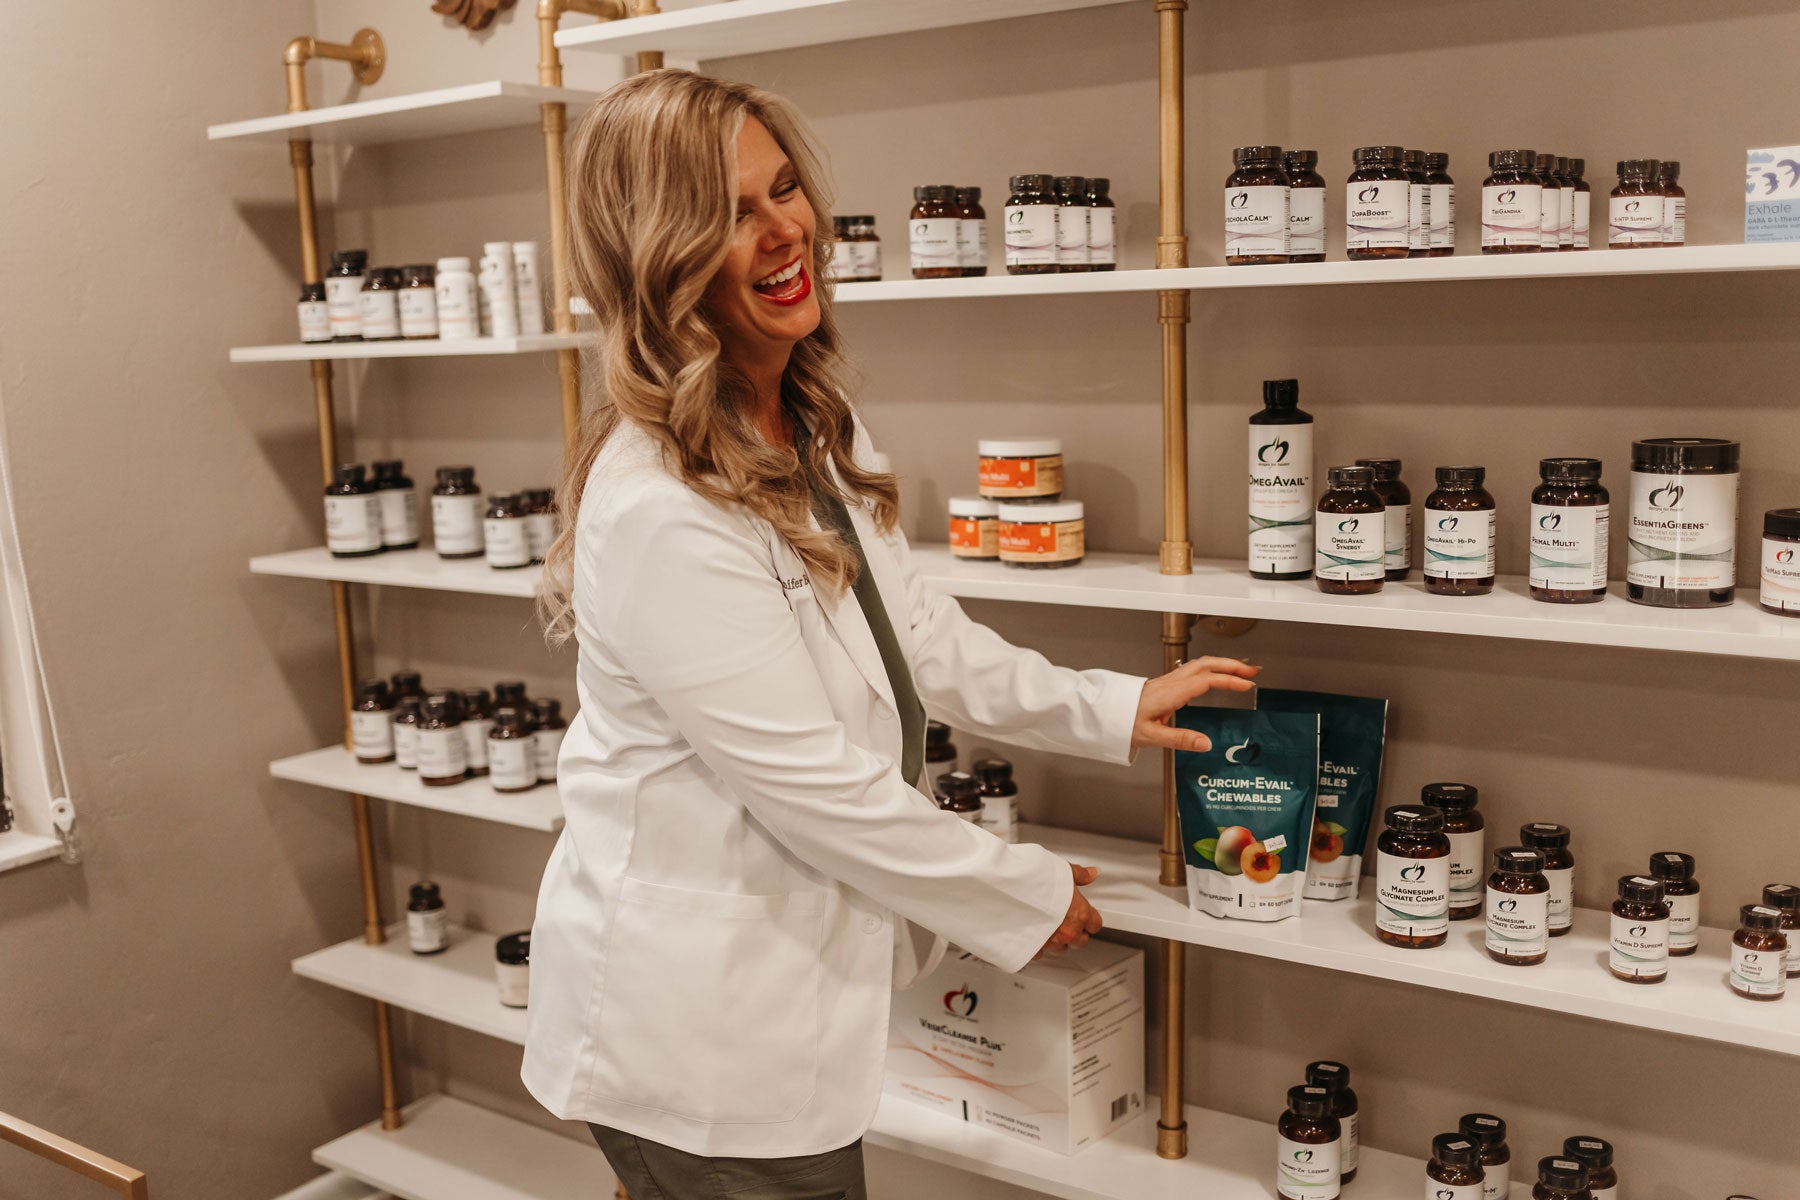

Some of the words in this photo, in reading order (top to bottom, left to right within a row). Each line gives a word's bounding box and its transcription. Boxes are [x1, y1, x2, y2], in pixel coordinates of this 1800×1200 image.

[1748, 203, 1792, 215] Exhale
[1206, 788, 1282, 804] CHEWABLES
[1380, 888, 1413, 902] GLYCINATE
[1415, 894, 1445, 903] COMPLEX
[1391, 885, 1434, 896] MAGNESIUM
